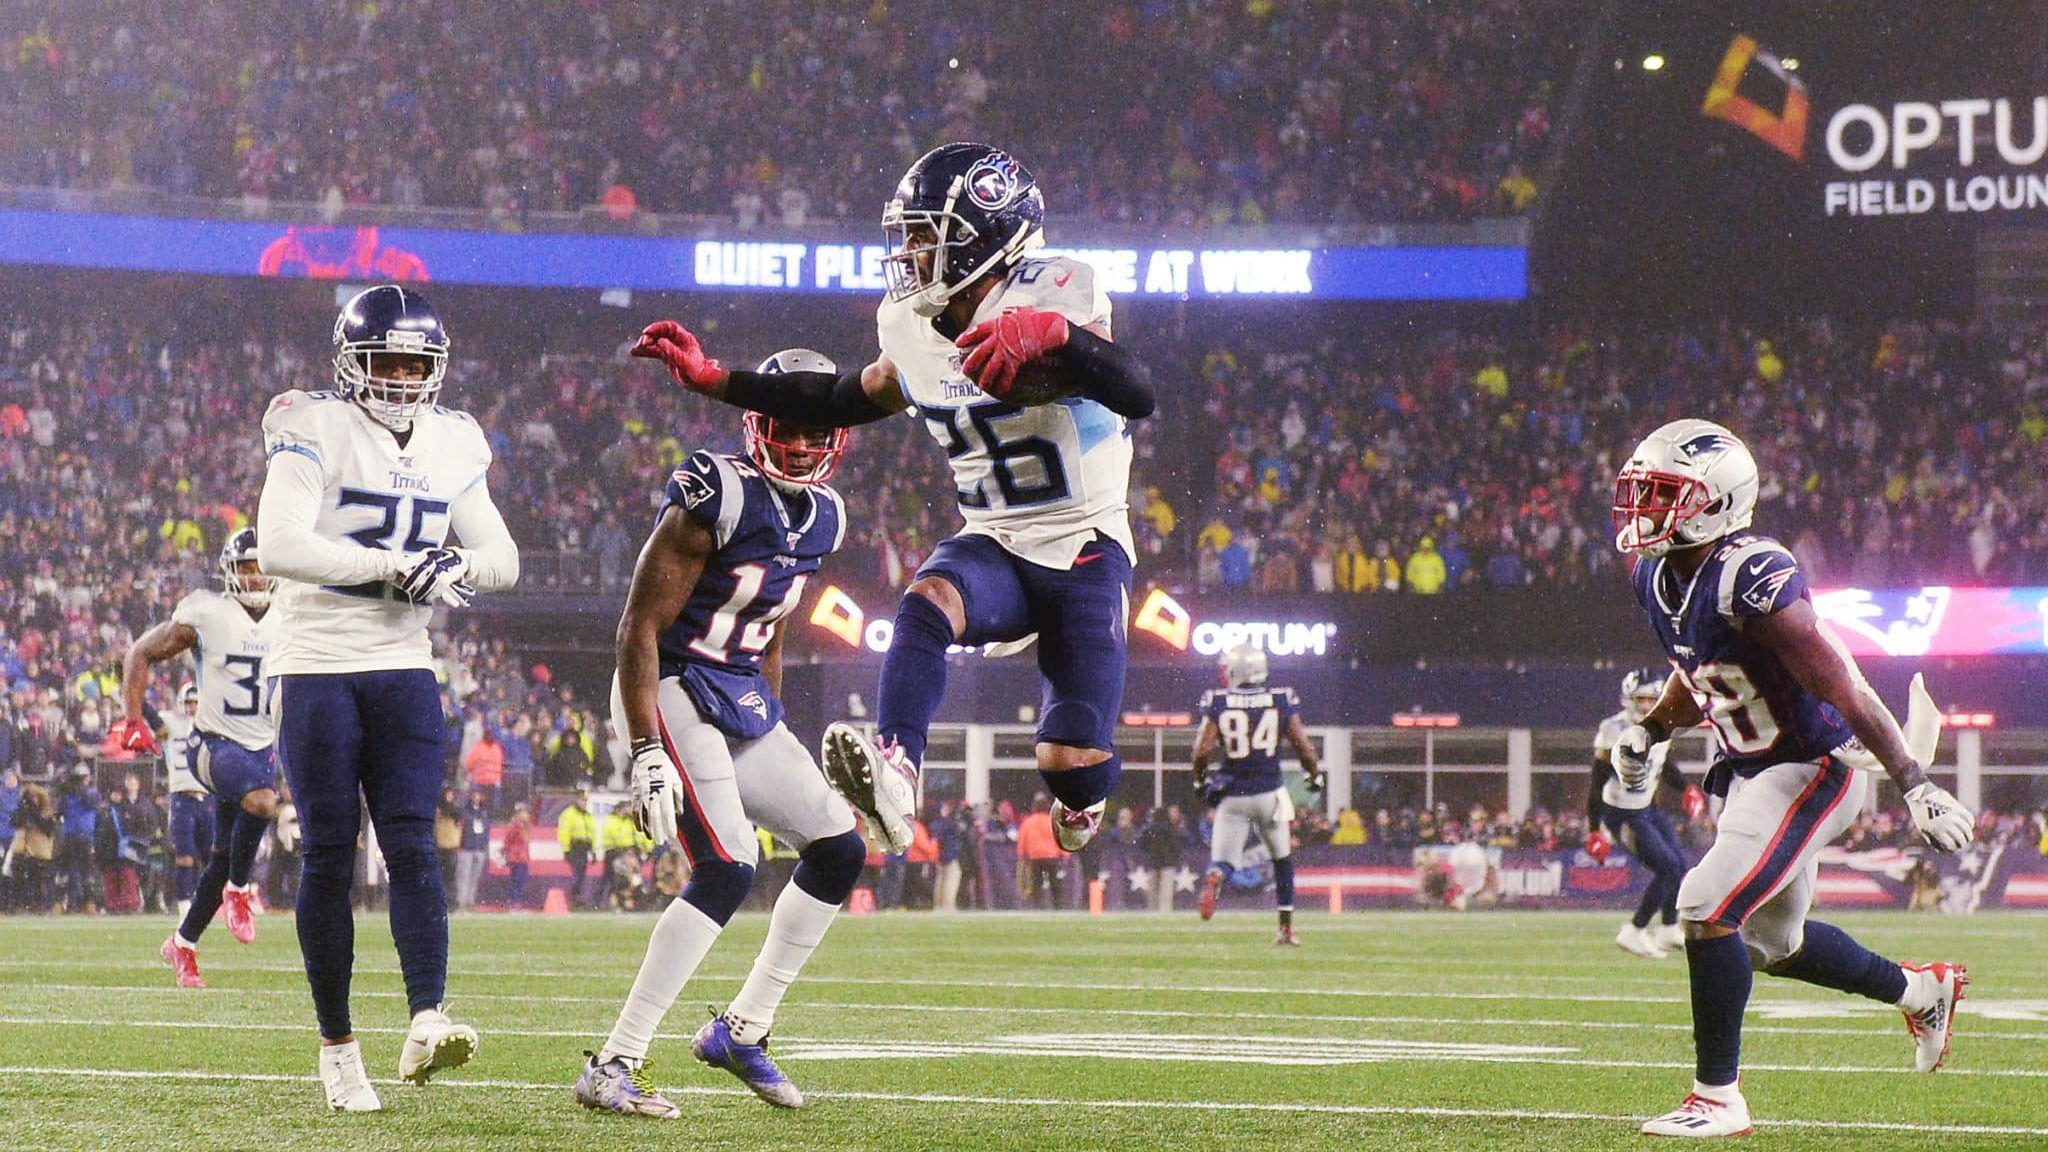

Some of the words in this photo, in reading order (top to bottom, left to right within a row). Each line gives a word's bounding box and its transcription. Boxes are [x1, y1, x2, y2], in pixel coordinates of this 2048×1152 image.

[1826, 96, 2048, 171] OPTU
[1825, 180, 1935, 216] FIELD
[1945, 174, 2048, 212] LOUN
[695, 241, 806, 287] QUIET
[815, 245, 908, 289] PLE
[1145, 250, 1194, 293] AT
[1201, 250, 1312, 293] WORK
[1192, 621, 1326, 656] OPTUM
[223, 653, 271, 716] 3
[1218, 707, 1280, 759] 84
